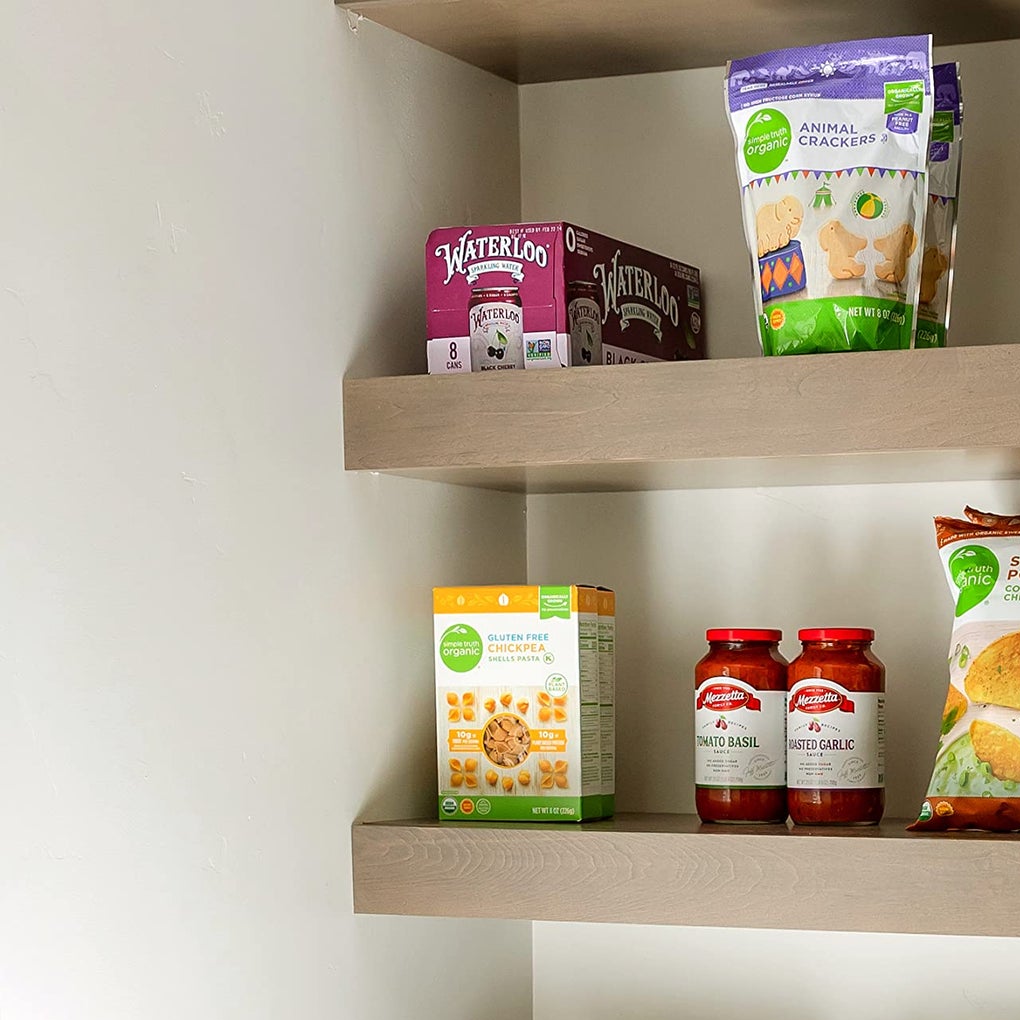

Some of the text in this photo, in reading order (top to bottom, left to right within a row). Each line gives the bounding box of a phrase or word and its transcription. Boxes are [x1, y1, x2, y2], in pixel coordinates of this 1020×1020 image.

[799, 122, 858, 135] ANIMAL
[747, 127, 788, 144] simple truth
[798, 133, 876, 148] CRACKERS
[746, 137, 789, 156] organic
[434, 229, 548, 285] WATERLOO
[470, 262, 519, 273] SPARKLING WATER
[592, 249, 679, 327] WATERLOO
[470, 305, 520, 333] WATERLOO
[848, 306, 863, 317] NET
[864, 306, 876, 317] WT
[876, 308, 882, 318] 8
[882, 309, 890, 319] OZ
[449, 341, 458, 360] 8
[446, 361, 462, 370] CANS
[487, 633, 550, 642] GLUTEN FREE
[442, 646, 480, 657] organic
[487, 643, 547, 653] CHICKPEA
[702, 690, 745, 705] Mezzetta
[794, 691, 838, 707] Mezzetta
[456, 731, 473, 740] 10g
[539, 731, 554, 740] 10g
[696, 735, 760, 748] TOMATO BASIL
[819, 739, 855, 751] GARLIC
